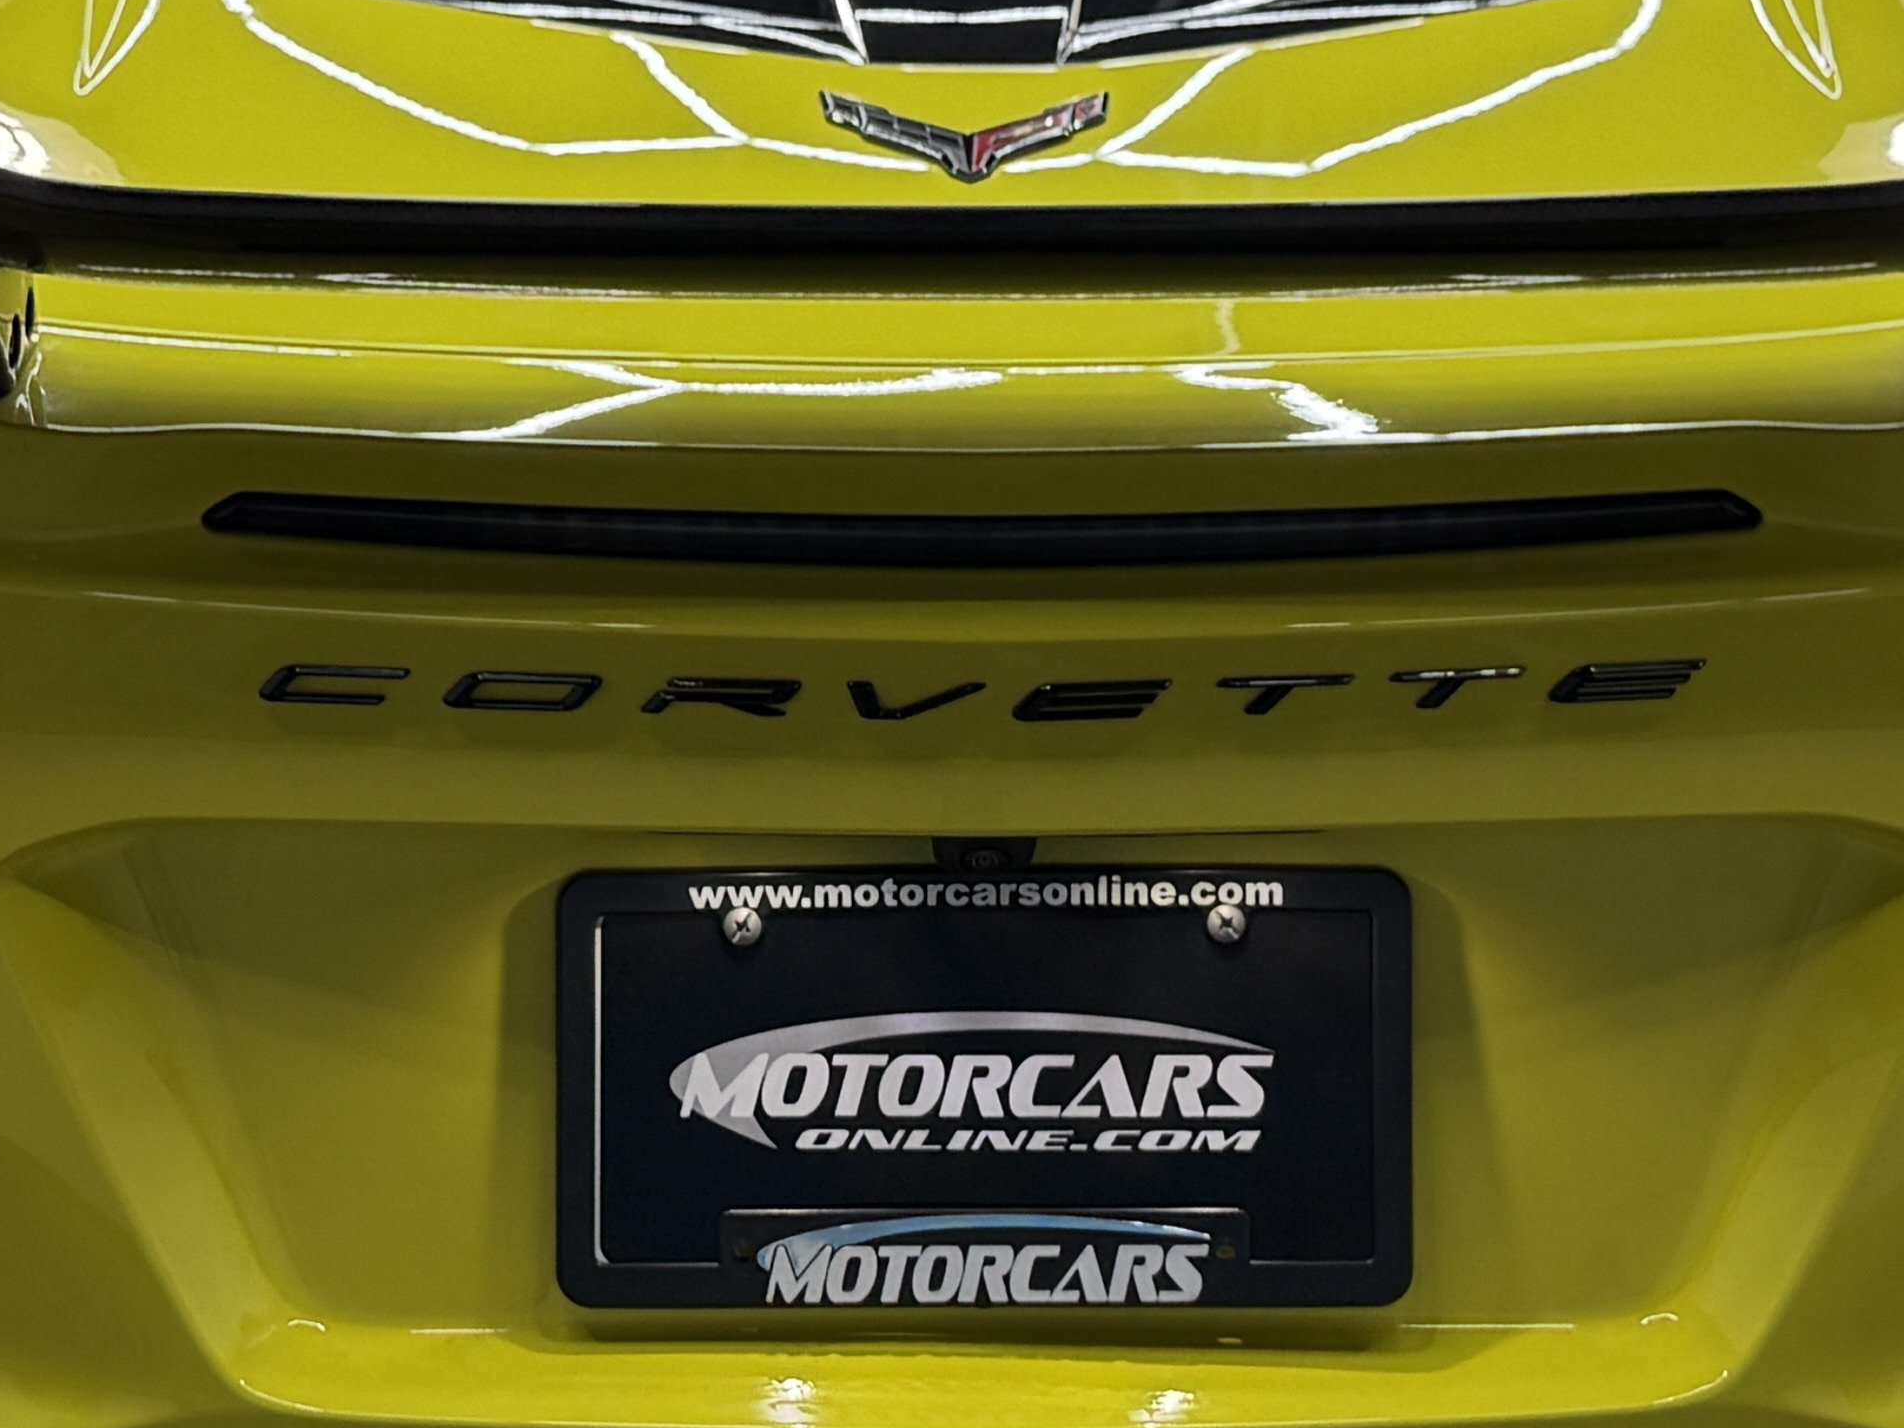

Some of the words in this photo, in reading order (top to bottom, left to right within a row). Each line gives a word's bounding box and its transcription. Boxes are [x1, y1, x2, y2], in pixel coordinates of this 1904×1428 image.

[258, 658, 1707, 720] CORVETTE
[689, 874, 1284, 910] www.motorcarsonline.com
[679, 1052, 1275, 1120] MOTORCARS
[794, 1127, 1262, 1152] ONLINE.COM
[764, 1242, 1210, 1304] MOTORCARS
